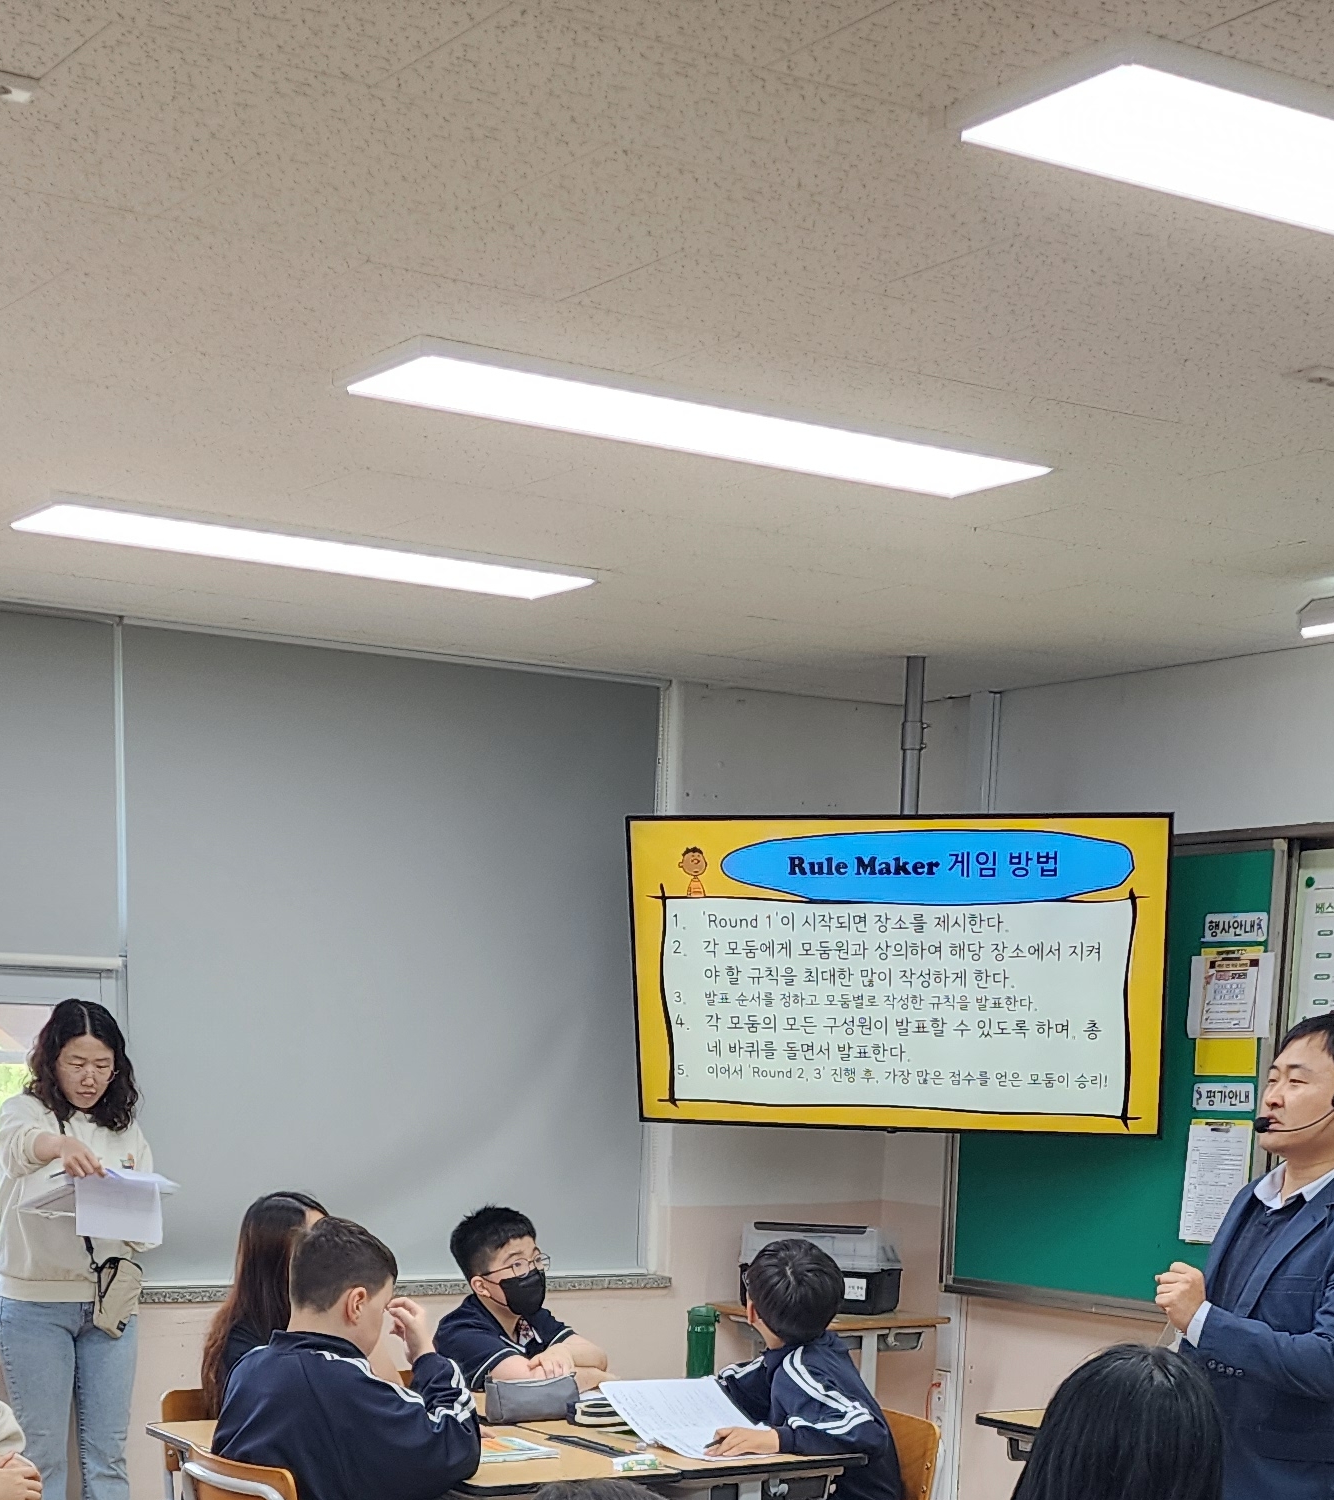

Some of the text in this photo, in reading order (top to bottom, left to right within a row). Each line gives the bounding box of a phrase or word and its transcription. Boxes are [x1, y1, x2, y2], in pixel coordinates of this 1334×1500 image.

[787, 850, 1058, 878] Rule Maker 게임 방법
[672, 913, 686, 930] 1.
[702, 911, 758, 929] 'Round
[802, 912, 867, 933] 시작되면
[873, 912, 928, 934] 장소를
[933, 912, 1009, 934] 제시한다.
[1207, 919, 1255, 938] 행사안내
[672, 938, 1102, 962] 2. 각 모둠에게 모둠원과 상의하여 해당 장소에서 지켜
[704, 965, 1015, 989] 야 할 규칙을 최대한 많이 작성하게 한다.
[673, 990, 1038, 1012] 3. 발표 순서를 정하고 모둠별로 작성한 규칙을 발표한다.
[675, 1014, 690, 1031] 4.
[705, 1013, 721, 1032] 각
[726, 1014, 777, 1033] 모둠의
[782, 1016, 818, 1034] 모든
[823, 1015, 888, 1036] 구성원이
[895, 1017, 948, 1038] 발표할
[952, 1019, 971, 1038] 수
[977, 1018, 1030, 1039] 있도록
[1082, 1019, 1102, 1040] 총
[707, 1039, 911, 1063] 네 바퀴를 돌면서 발표한다.
[677, 1064, 1108, 1090] 5. 이어서 'Round 2, 3' 진행 후, 가장 많은 점수를 얻은 모둠이 승리!
[1205, 1089, 1250, 1107] 평가안내
